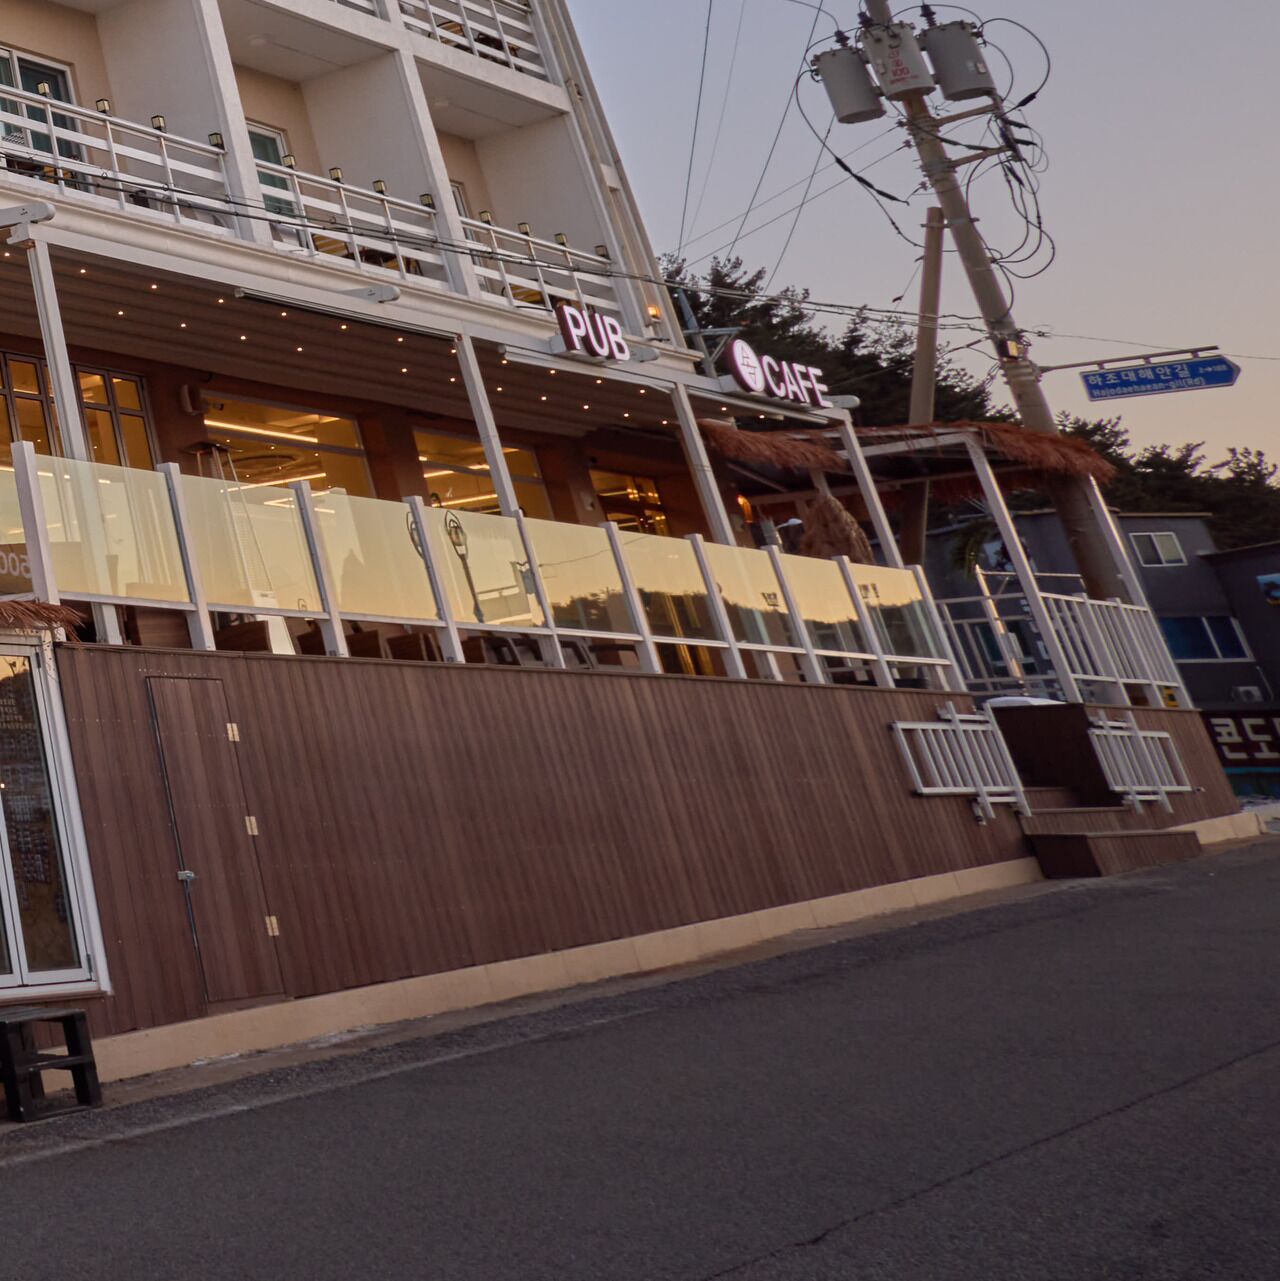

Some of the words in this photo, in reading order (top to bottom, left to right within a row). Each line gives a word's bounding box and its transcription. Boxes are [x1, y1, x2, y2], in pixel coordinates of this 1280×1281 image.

[557, 304, 631, 362] PUB
[761, 354, 834, 410] CAFE
[1089, 364, 1191, 386] 하조대해안길
[1209, 716, 1280, 760] 콘도
